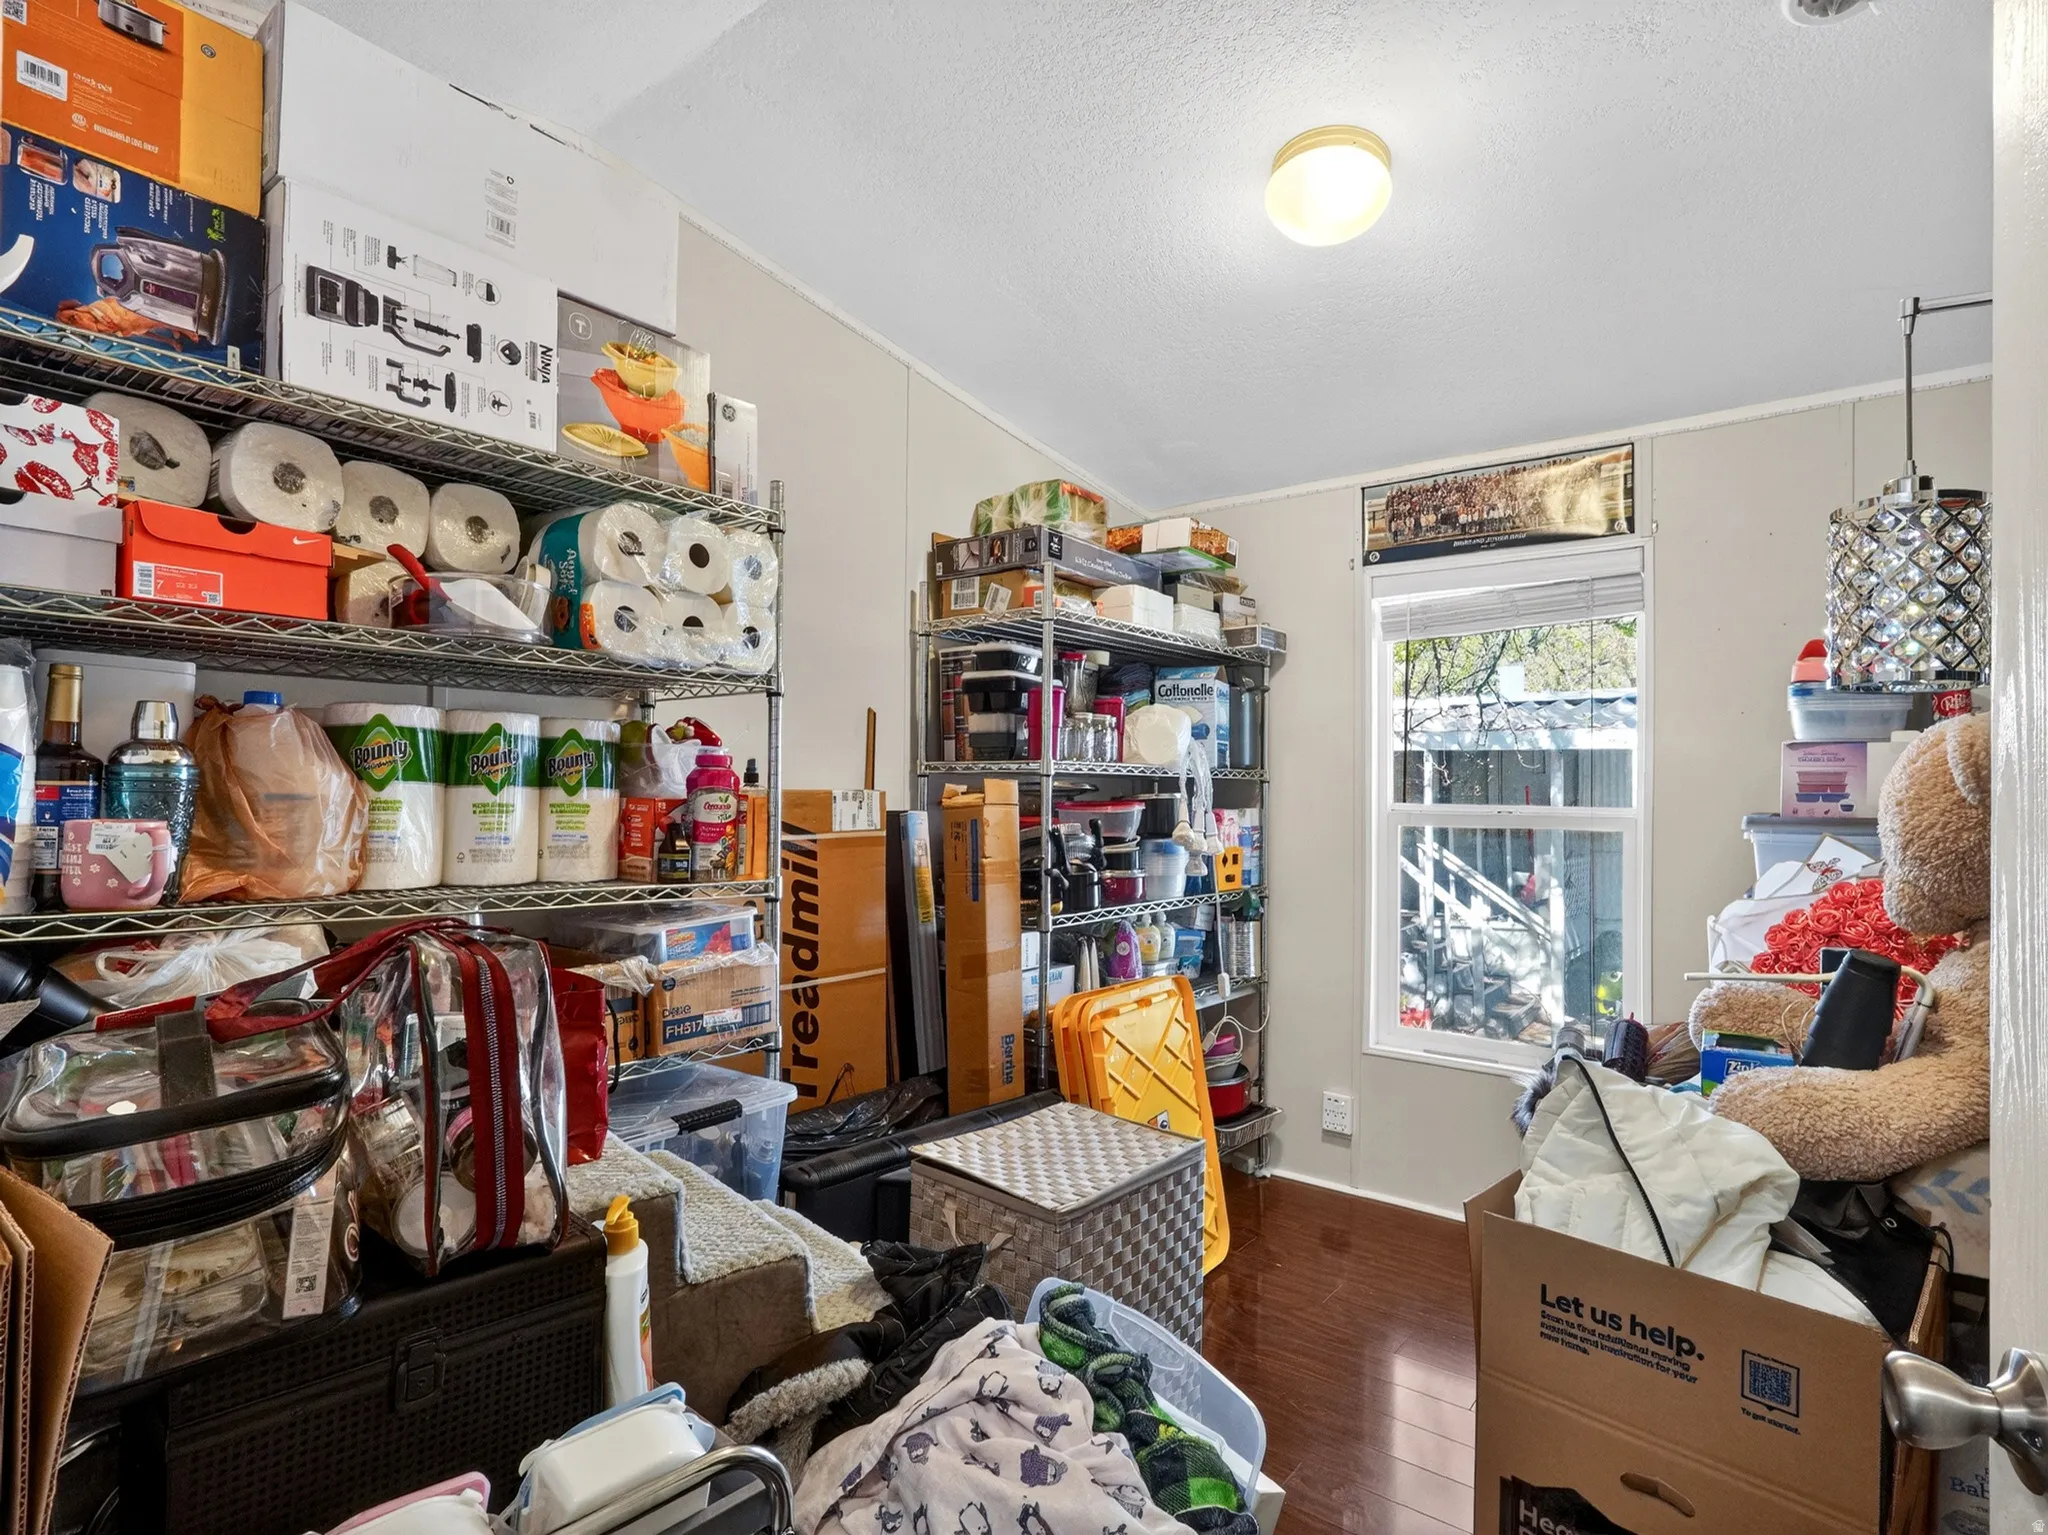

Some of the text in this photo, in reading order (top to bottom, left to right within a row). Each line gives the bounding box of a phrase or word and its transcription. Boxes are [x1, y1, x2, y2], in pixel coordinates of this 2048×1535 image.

[537, 344, 554, 384] NINJA
[156, 580, 164, 589] 7
[1158, 683, 1214, 698] Cottonelle
[353, 739, 409, 770] Bounty
[469, 748, 520, 777] Bounty
[547, 751, 596, 778] Bounty
[781, 821, 819, 1099] Treadmill
[1541, 1283, 1705, 1361] Let us help.
[1577, 1323, 1596, 1337] find
[1579, 1336, 1599, 1349] and
[1656, 1360, 1671, 1375] for
